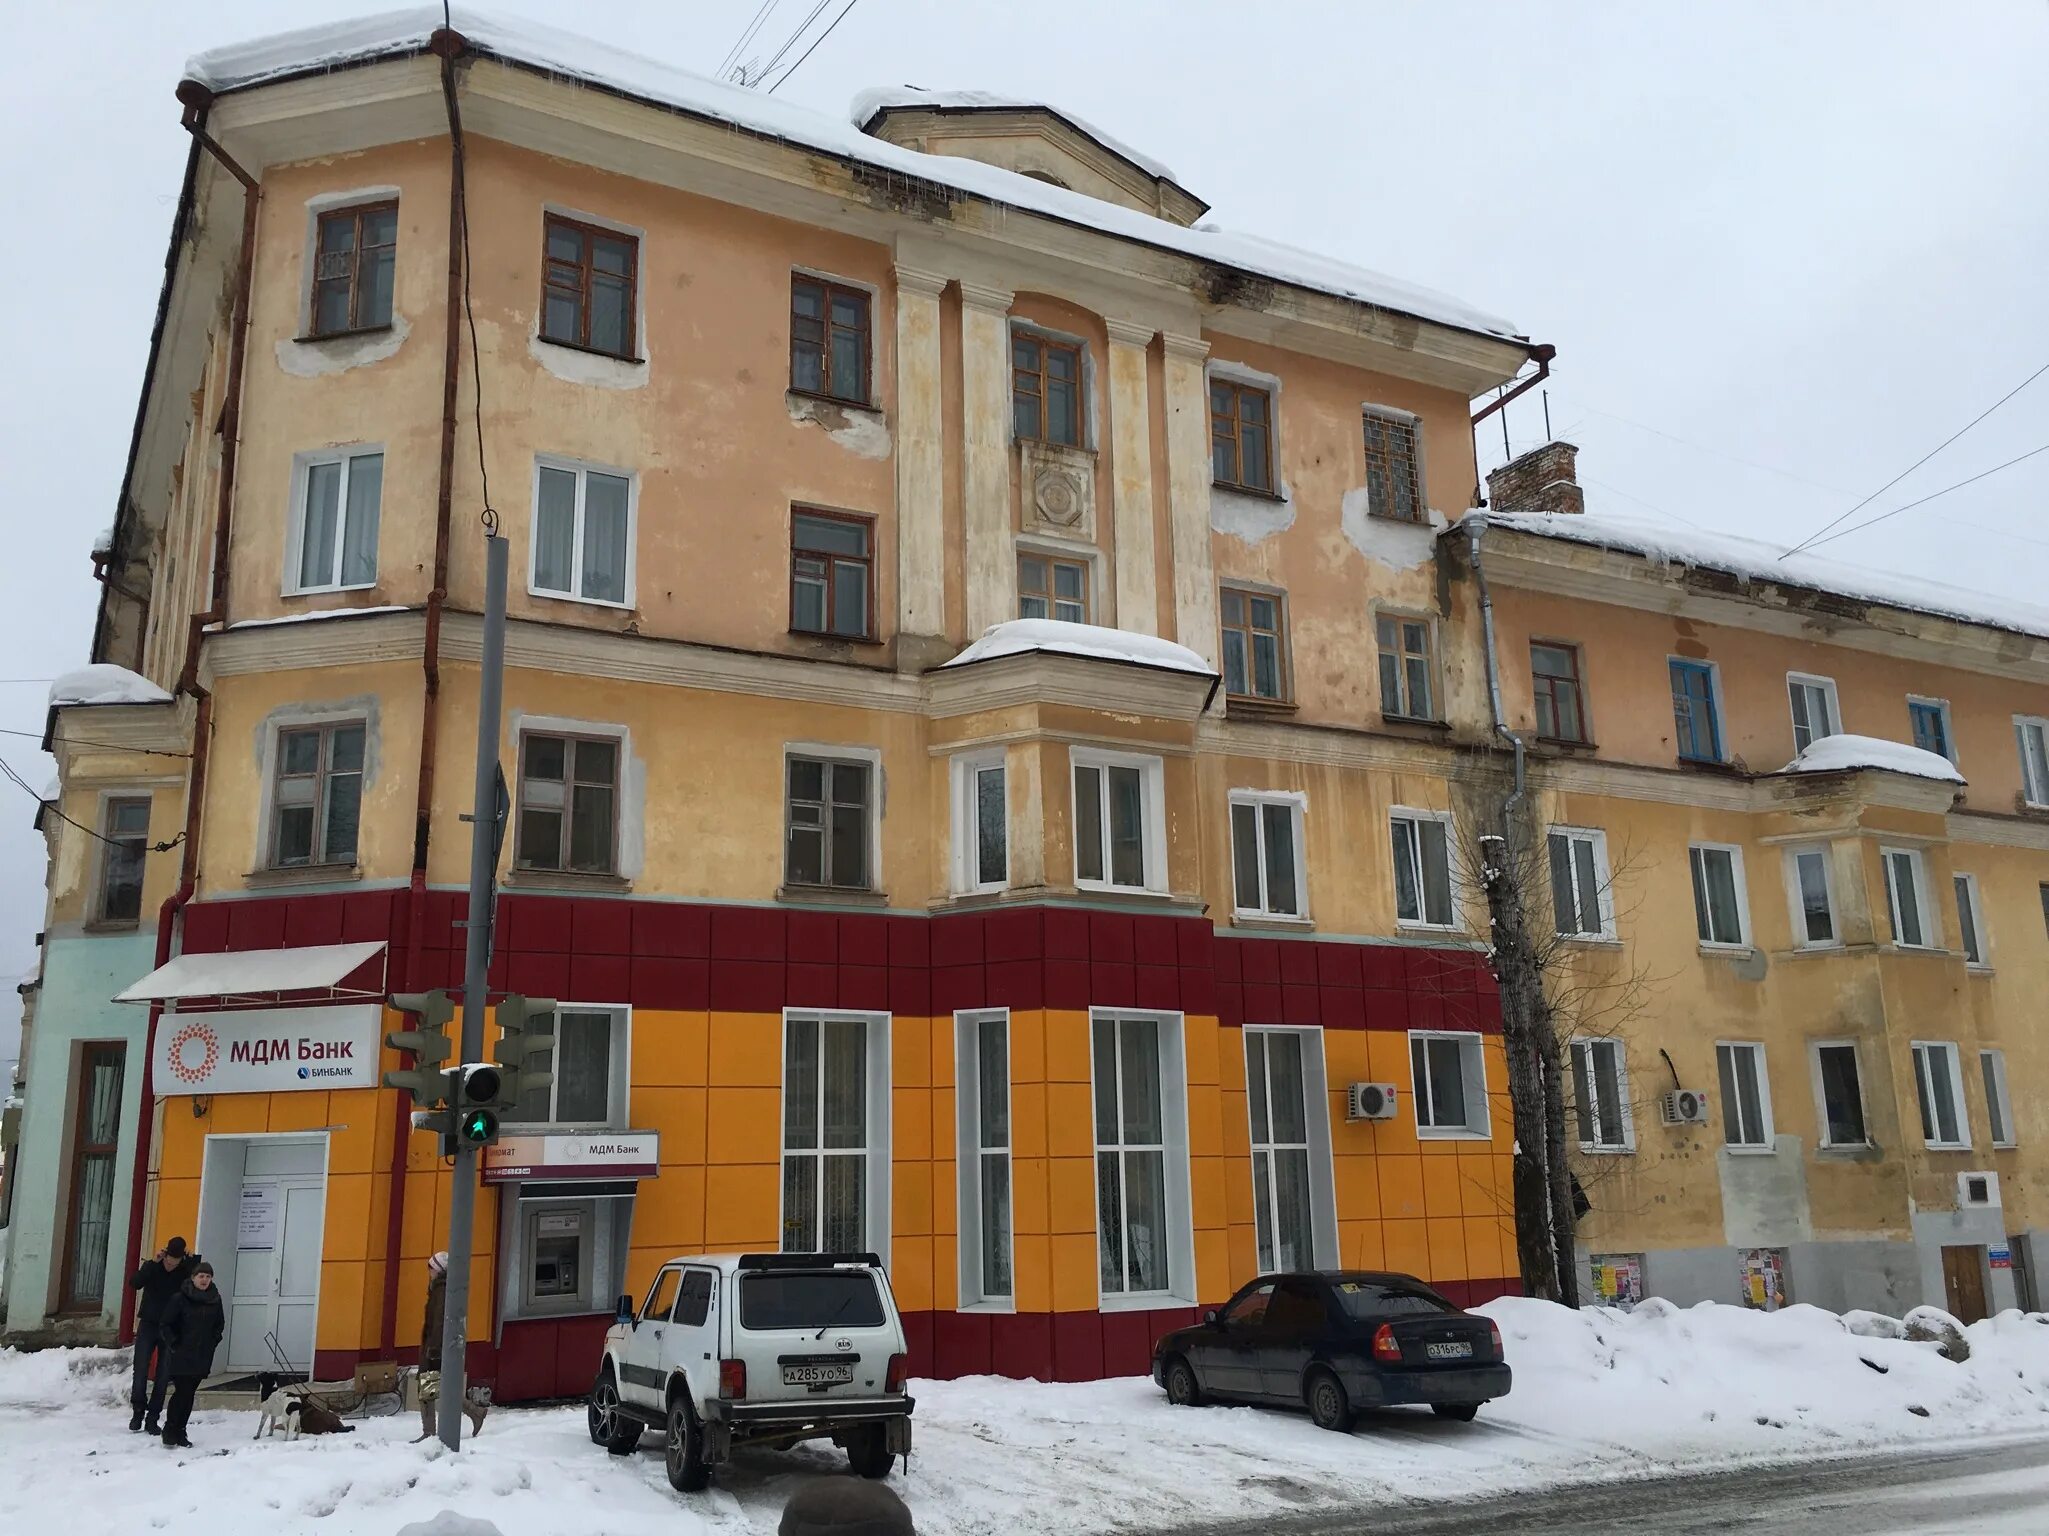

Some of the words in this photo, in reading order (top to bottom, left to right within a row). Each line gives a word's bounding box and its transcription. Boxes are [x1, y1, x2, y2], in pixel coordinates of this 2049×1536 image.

[230, 1039, 290, 1065] МДМ
[297, 1038, 353, 1060] Банк
[311, 1067, 353, 1077] БИНБАНК
[589, 1145, 615, 1155] МДМ
[616, 1145, 640, 1154] Банк
[836, 1366, 848, 1376] 96
